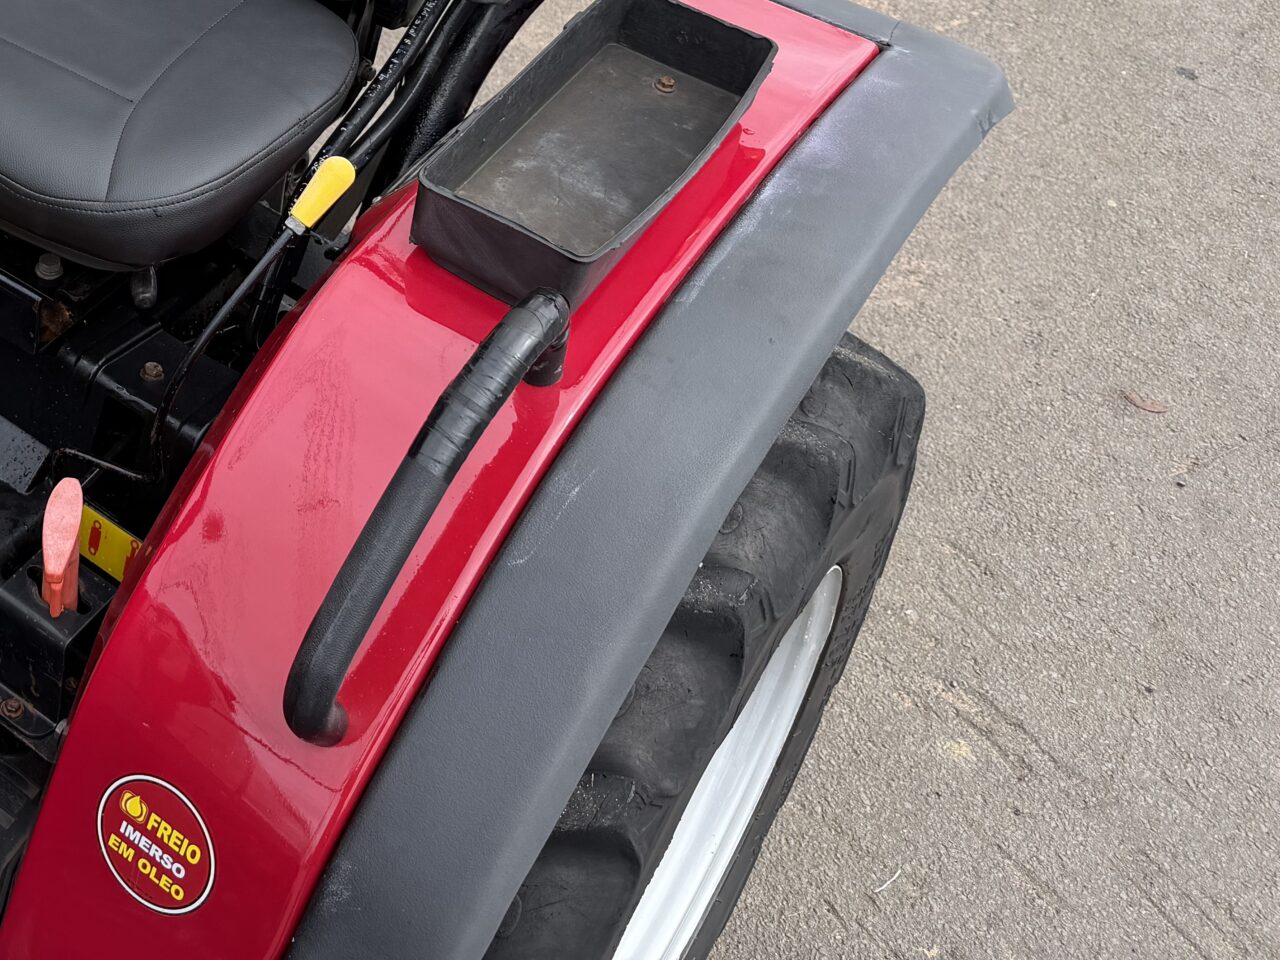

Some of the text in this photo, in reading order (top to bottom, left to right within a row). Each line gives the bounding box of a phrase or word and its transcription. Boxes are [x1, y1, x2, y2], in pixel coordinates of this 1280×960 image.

[108, 833, 184, 901] EM OLEO
[120, 820, 186, 879] IMERSO
[146, 812, 201, 864] FREIO
